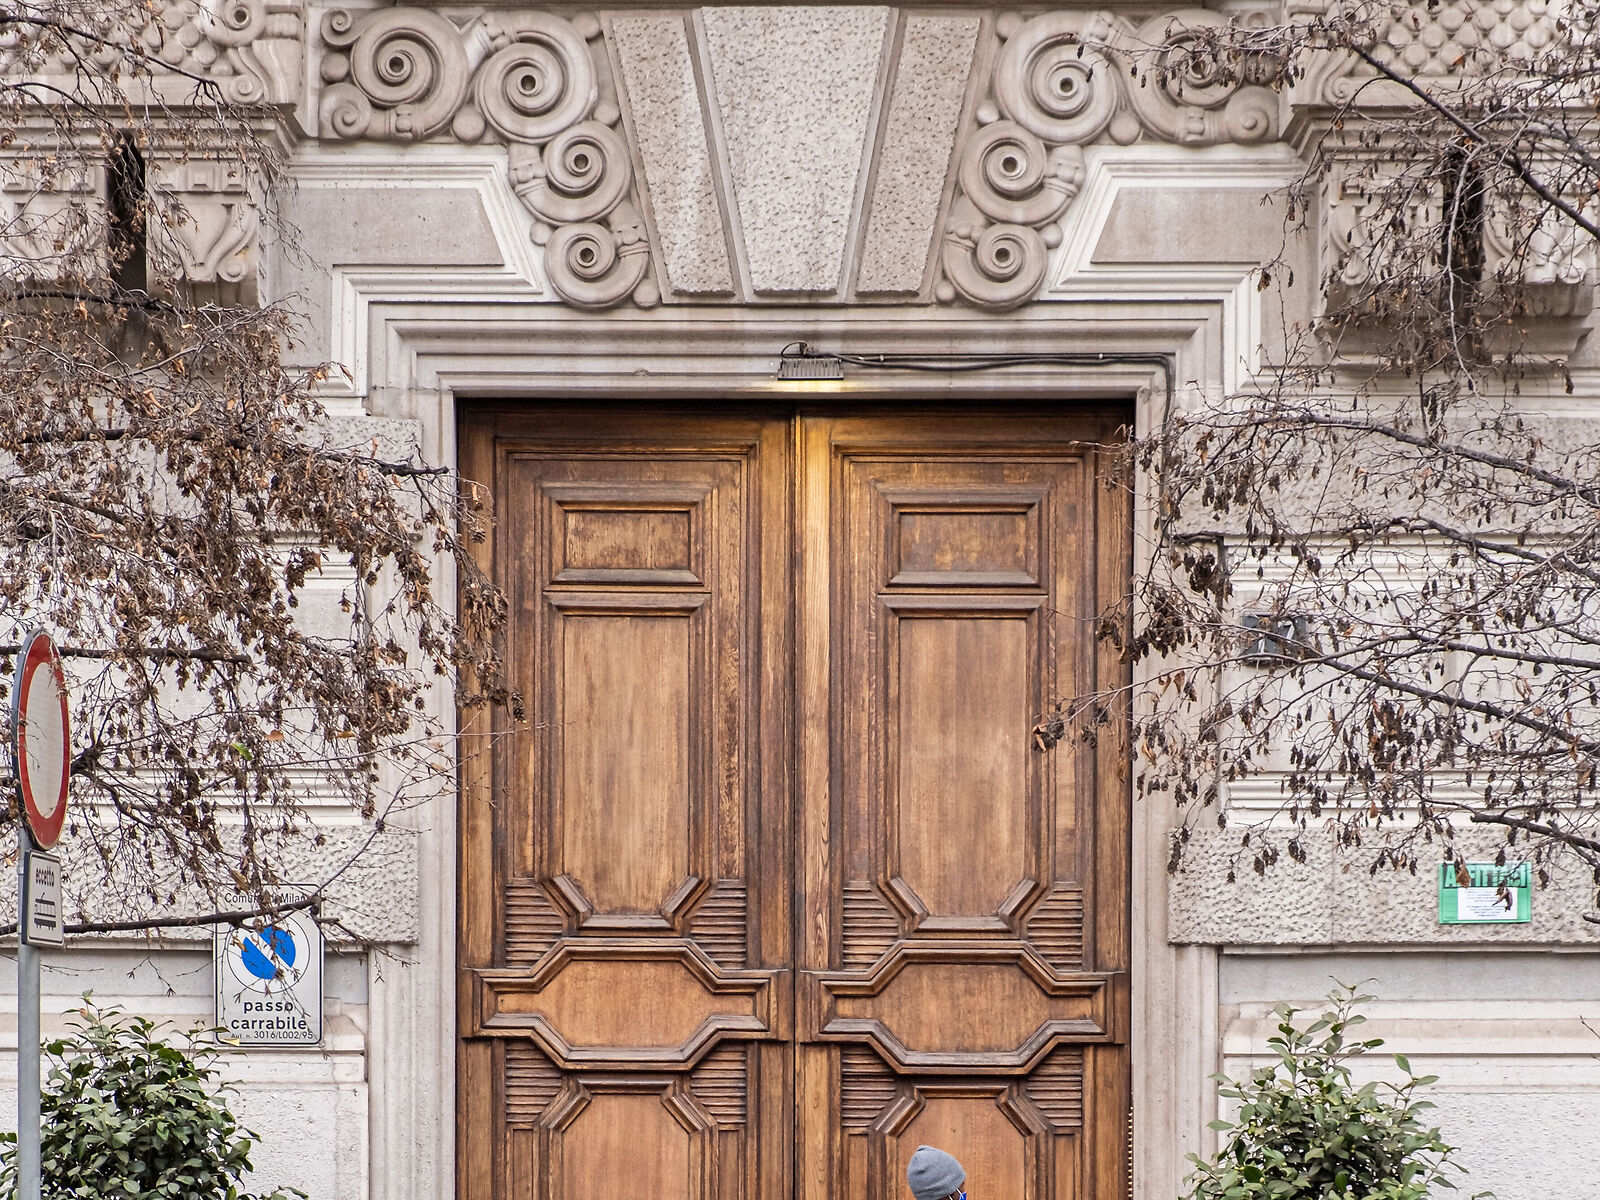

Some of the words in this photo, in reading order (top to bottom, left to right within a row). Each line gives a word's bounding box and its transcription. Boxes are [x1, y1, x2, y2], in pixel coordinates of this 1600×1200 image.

[36, 865, 54, 887] eccetto
[225, 893, 262, 903] Comu
[281, 893, 309, 903] Milan
[245, 1002, 293, 1014] passo
[231, 1016, 307, 1029] carrabile
[254, 1031, 314, 1040] 3016/L002/95
